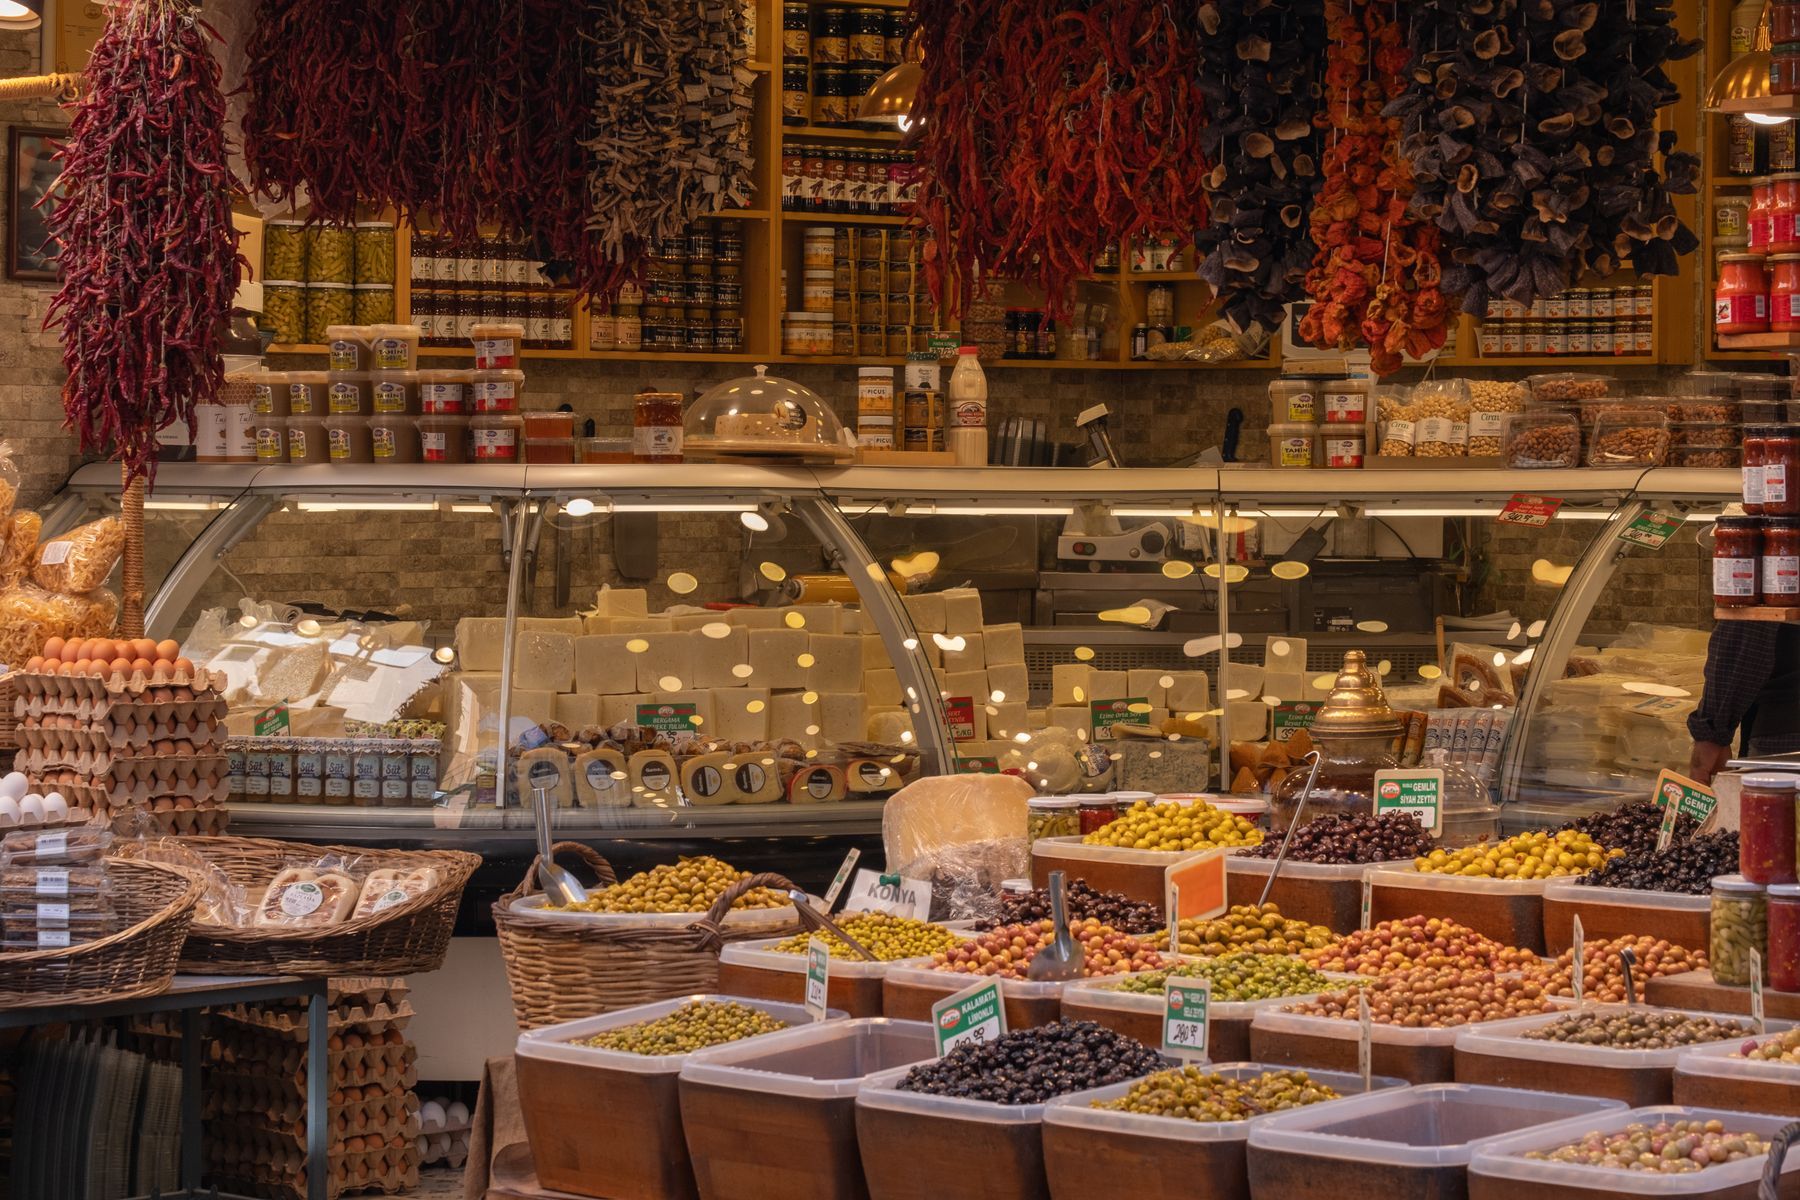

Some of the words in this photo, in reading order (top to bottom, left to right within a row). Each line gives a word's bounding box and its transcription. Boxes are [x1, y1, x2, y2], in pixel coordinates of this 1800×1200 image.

[1284, 446, 1308, 454] TAHİN
[329, 763, 345, 773] Süt
[386, 764, 401, 775] Süt
[415, 765, 431, 775] Süt
[1413, 781, 1437, 792] GEMLİK
[1400, 793, 1417, 804] SİYAH
[1416, 793, 1437, 804] ZEYTİN
[1684, 796, 1712, 813] GEMLİ
[867, 883, 917, 906] KONYA
[961, 989, 997, 1014] KALAMATA
[968, 1004, 995, 1025] LİMONLU
